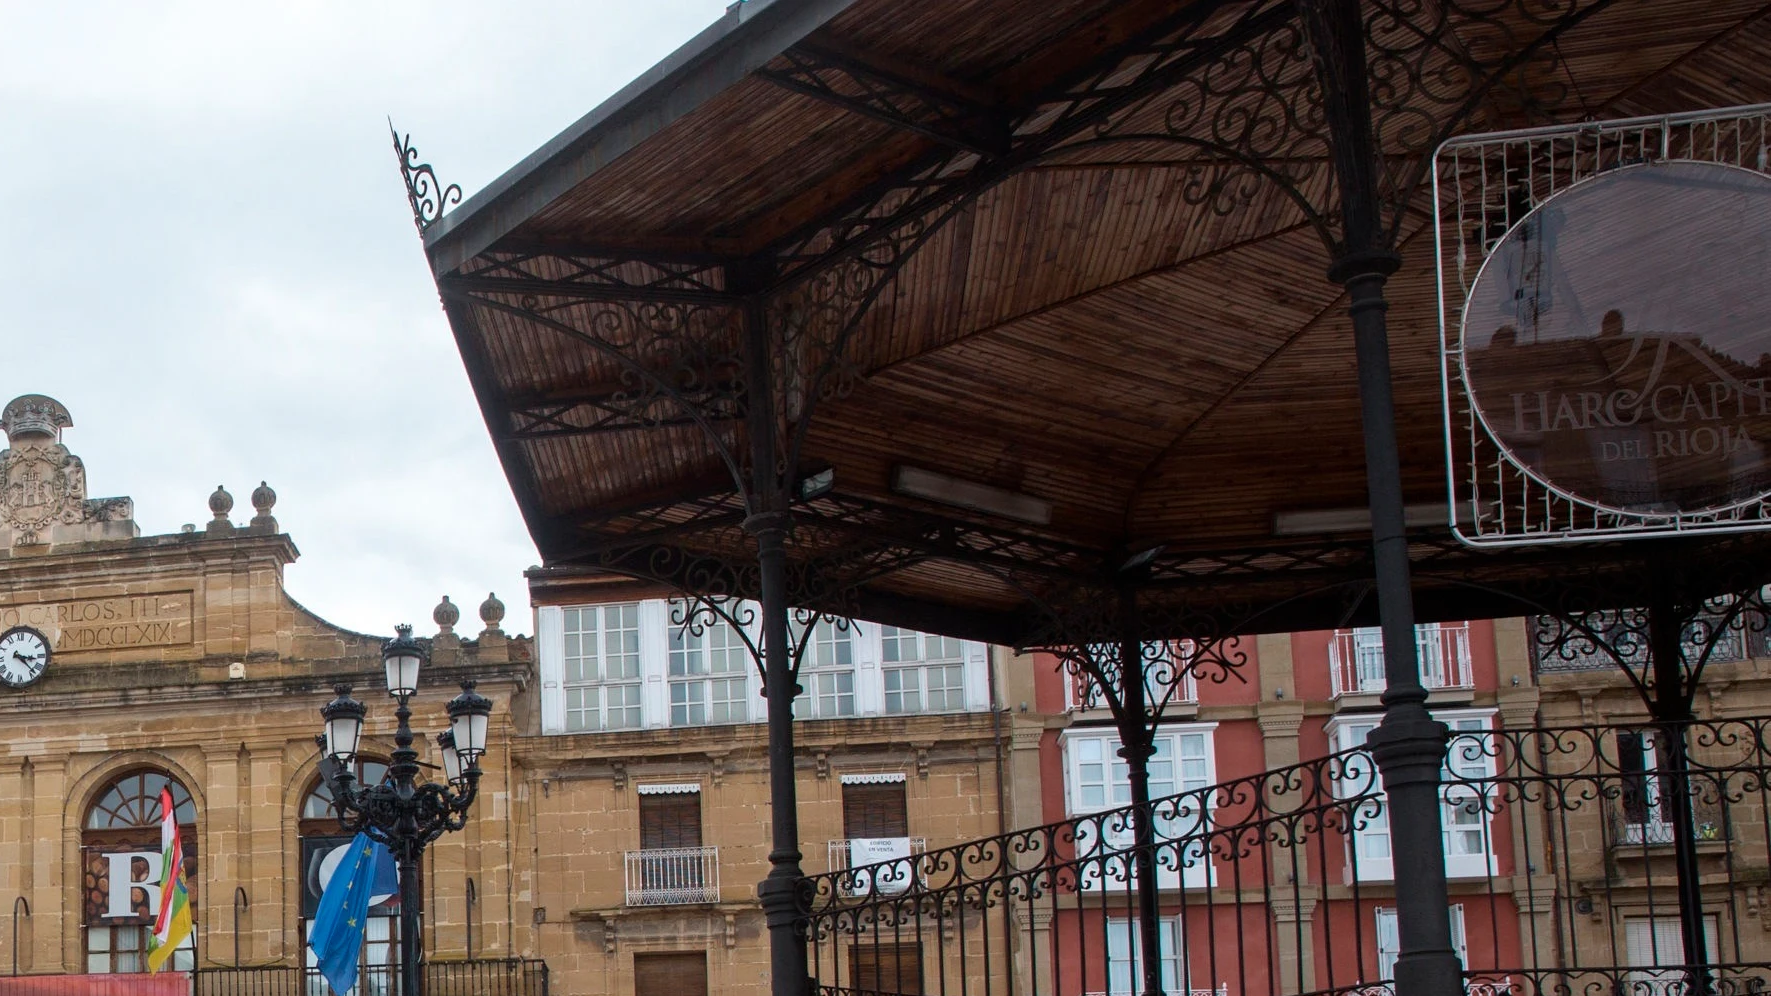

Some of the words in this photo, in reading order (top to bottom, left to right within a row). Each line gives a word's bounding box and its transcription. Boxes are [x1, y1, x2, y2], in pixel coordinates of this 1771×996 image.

[1509, 388, 1645, 434] HARO
[1601, 439, 1649, 462] DEL
[1652, 424, 1757, 461] RIOJA
